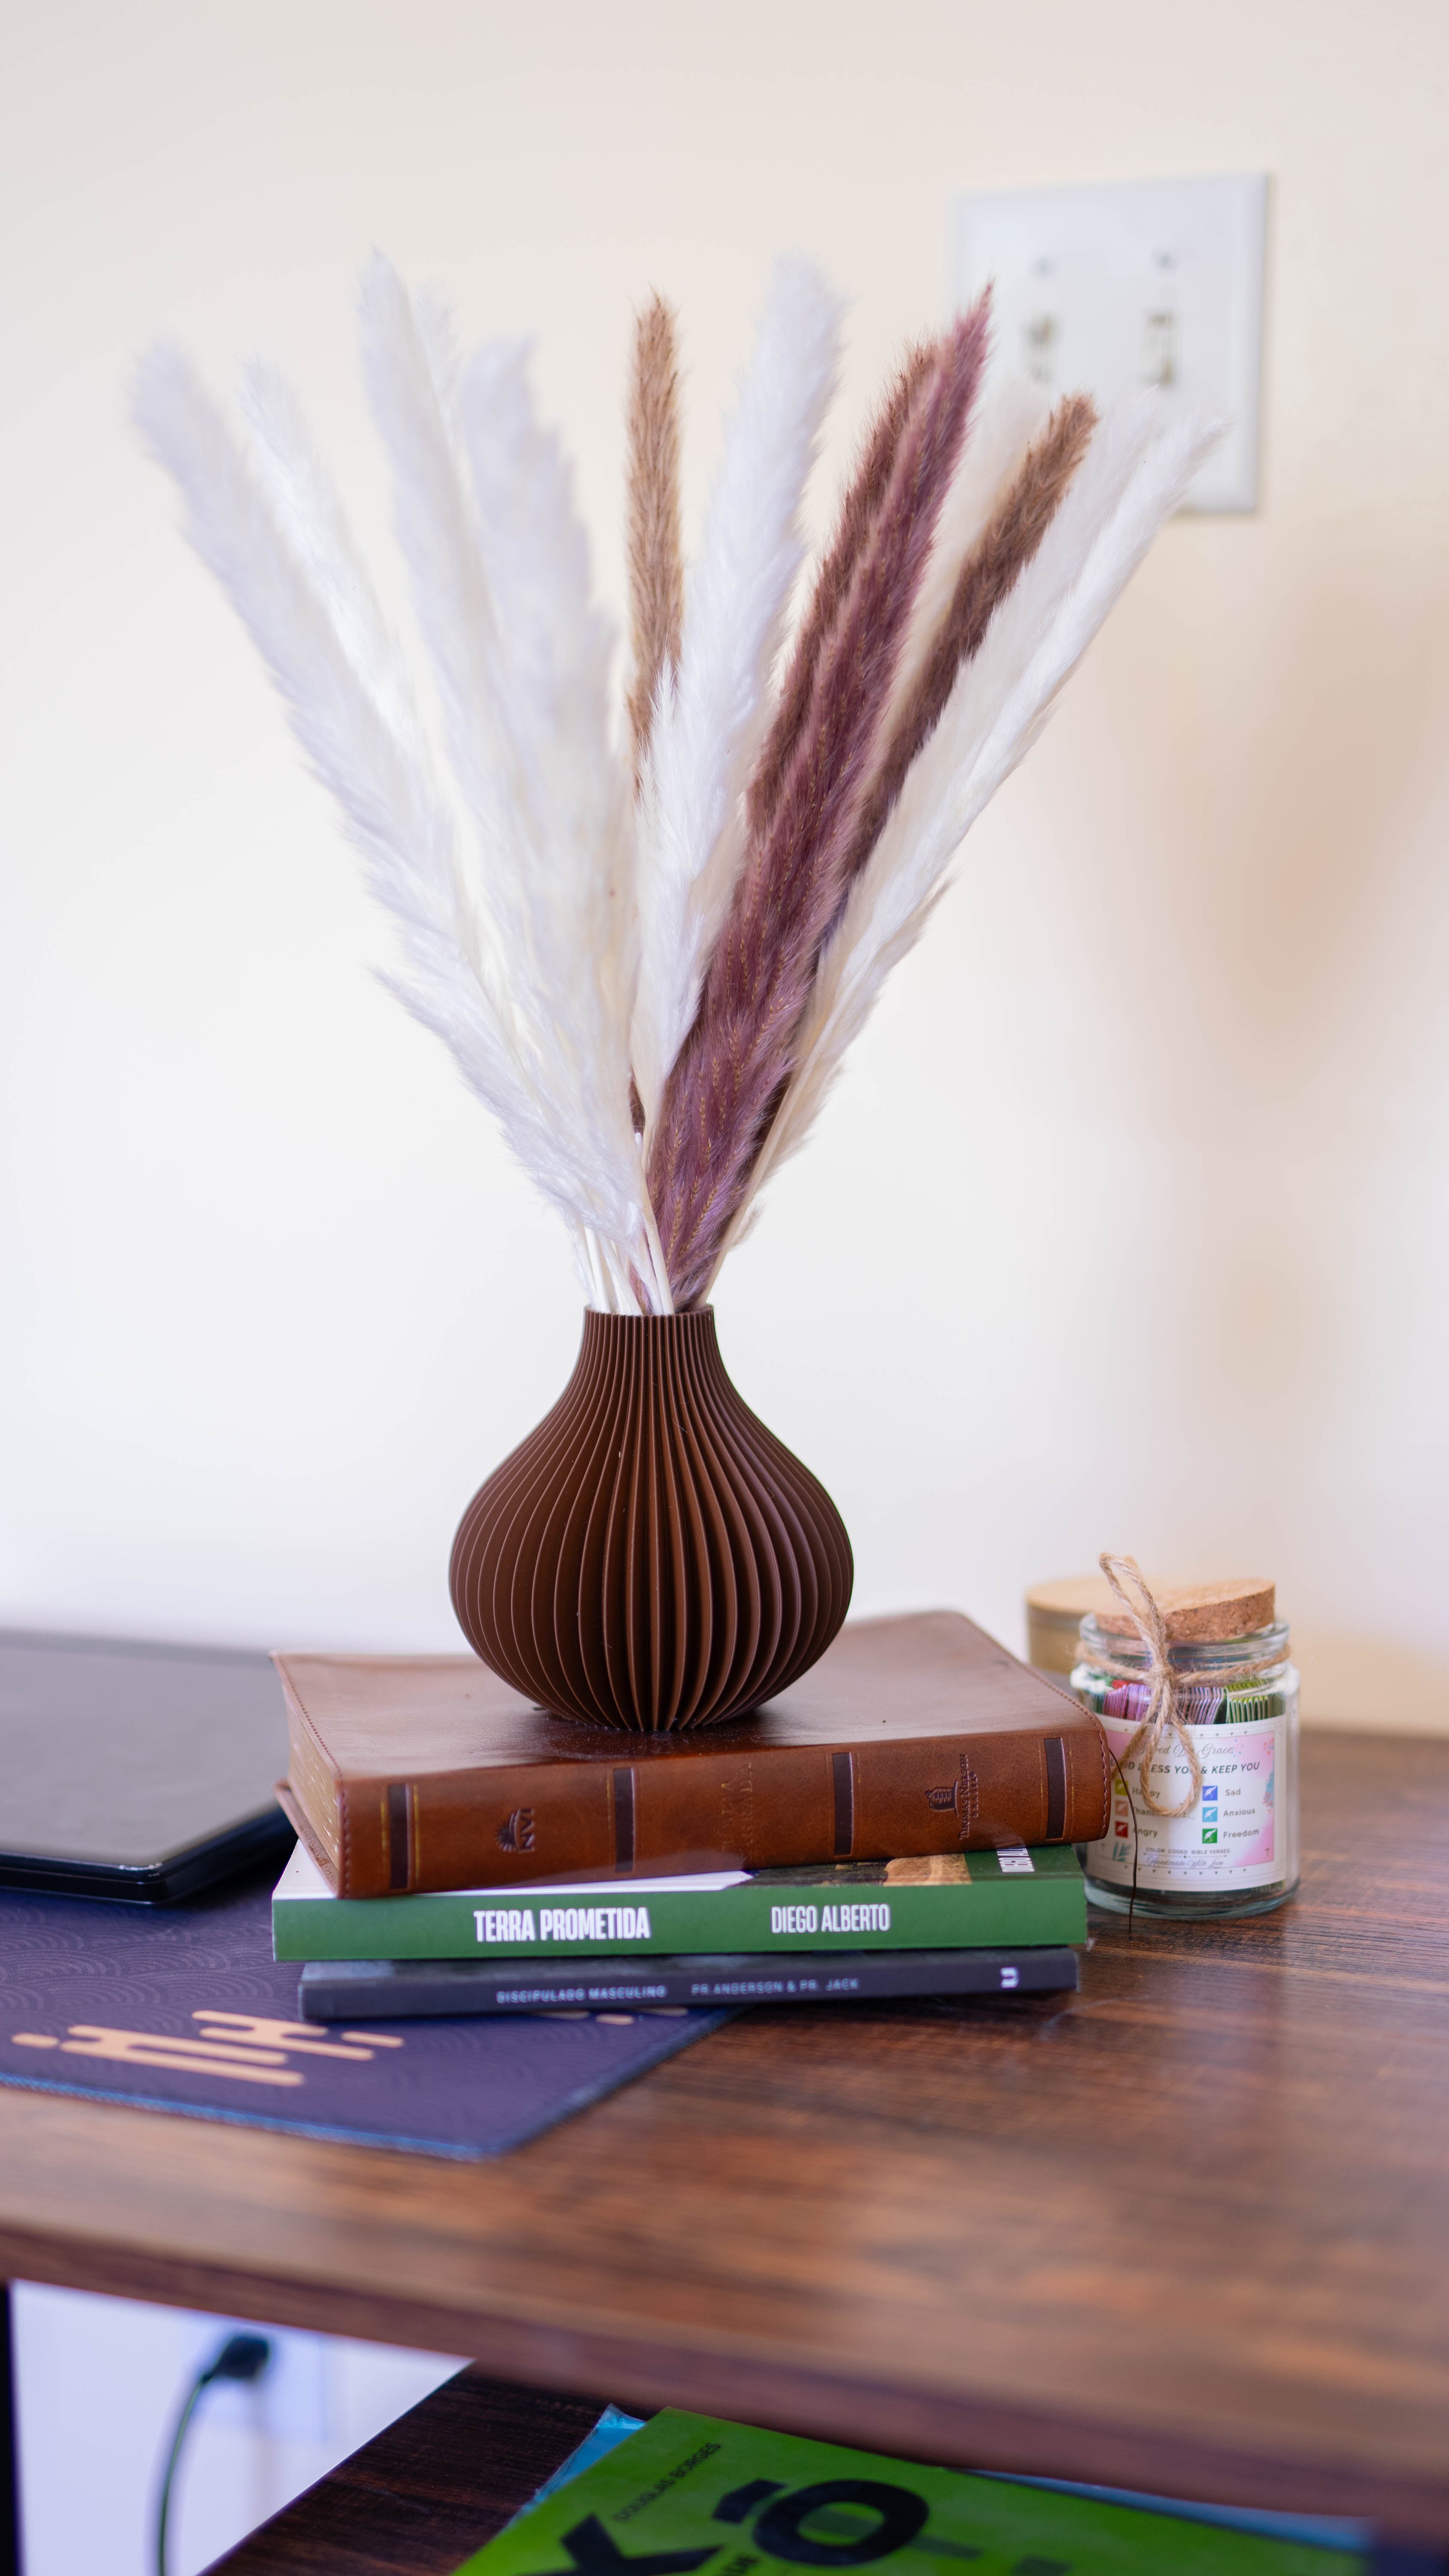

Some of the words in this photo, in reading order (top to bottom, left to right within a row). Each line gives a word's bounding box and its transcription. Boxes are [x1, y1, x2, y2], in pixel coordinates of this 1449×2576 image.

[1197, 1743, 1233, 1759] Grace
[959, 1753, 970, 1797] NELSON
[1175, 1765, 1193, 1774] YO
[1200, 1765, 1207, 1774] &
[1212, 1765, 1237, 1774] KEEP
[1241, 1762, 1260, 1772] YOU
[958, 1798, 970, 1840] THOMAS
[1223, 1808, 1256, 1817] Anxious
[1223, 1829, 1260, 1838] Freedom
[473, 1909, 536, 1942] TERRA
[540, 1907, 651, 1941] PROMETIDA
[771, 1905, 817, 1933] DIEGO
[821, 1903, 891, 1932] ALBERTO
[496, 1987, 585, 2004] DISCIPULADO
[588, 1985, 667, 2001] MASCULINO
[786, 1980, 796, 1993] &
[825, 1978, 859, 1992] JACK
[669, 2442, 722, 2479] BORGES
